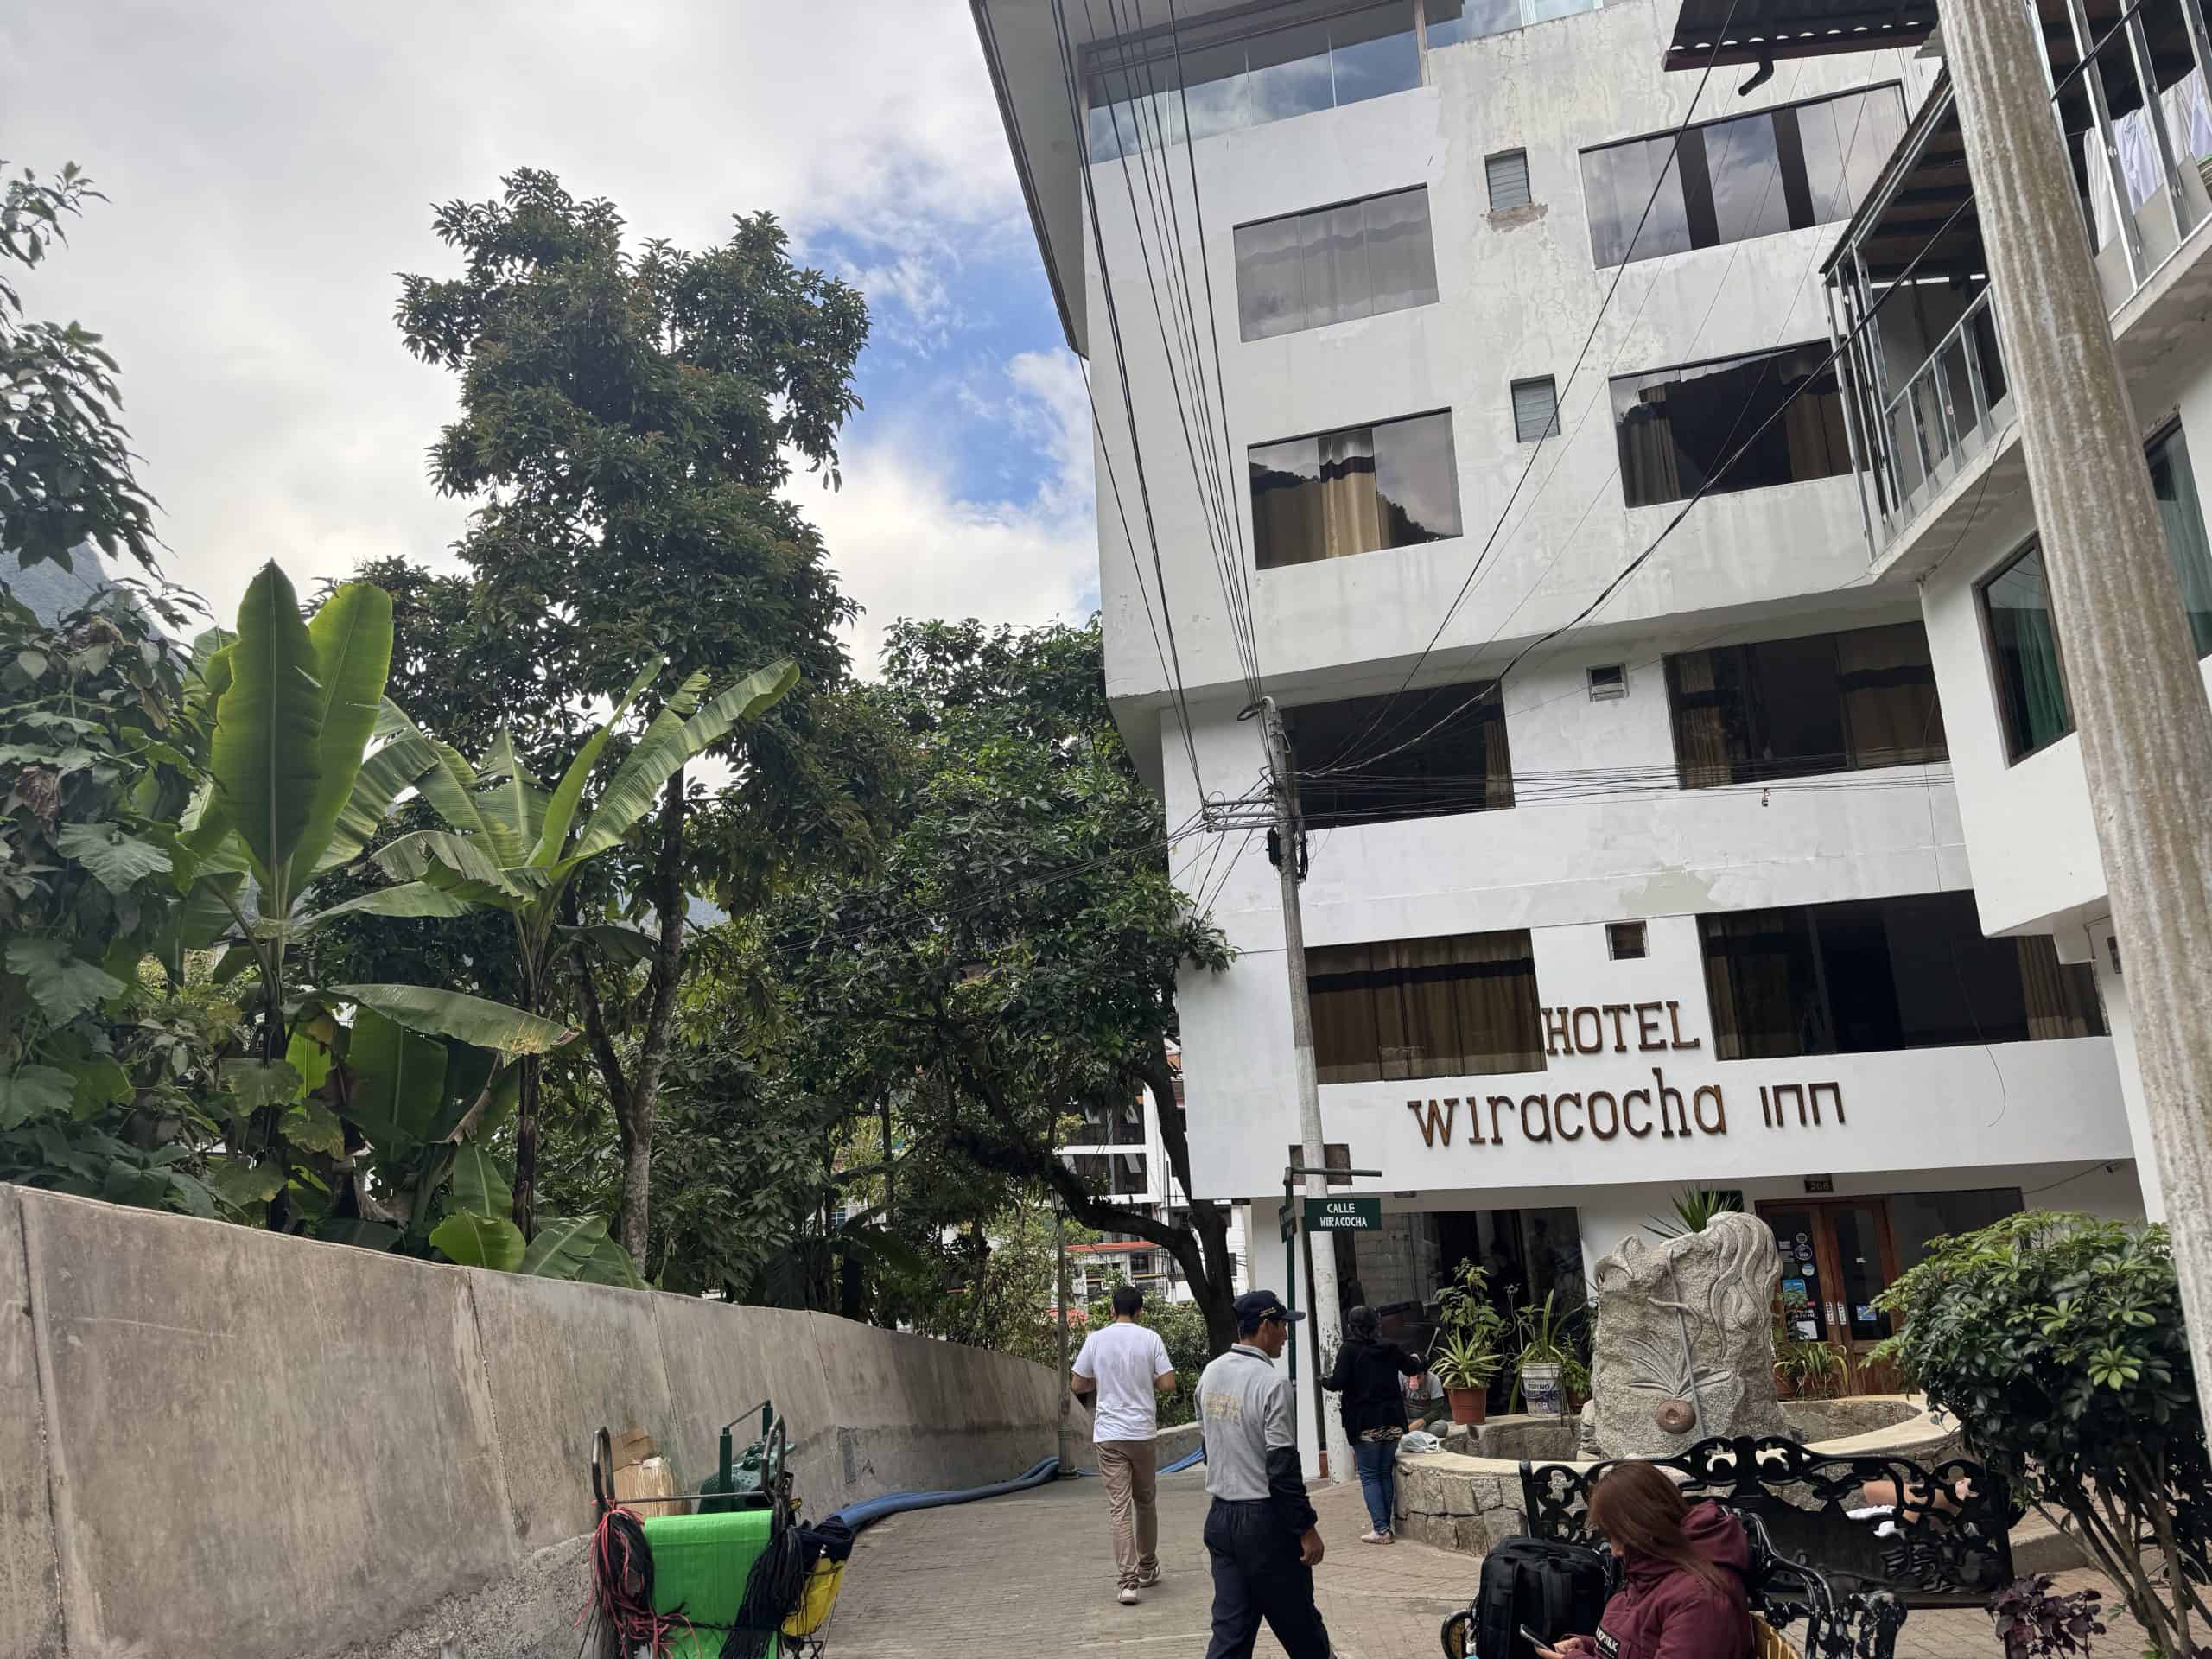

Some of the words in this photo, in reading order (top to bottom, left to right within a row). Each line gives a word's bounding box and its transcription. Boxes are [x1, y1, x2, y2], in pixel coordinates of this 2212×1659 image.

[1541, 1001, 1701, 1057] HOTEL
[1326, 1202, 1356, 1214] CALLE
[1319, 1217, 1368, 1228] WIRACOCHA
